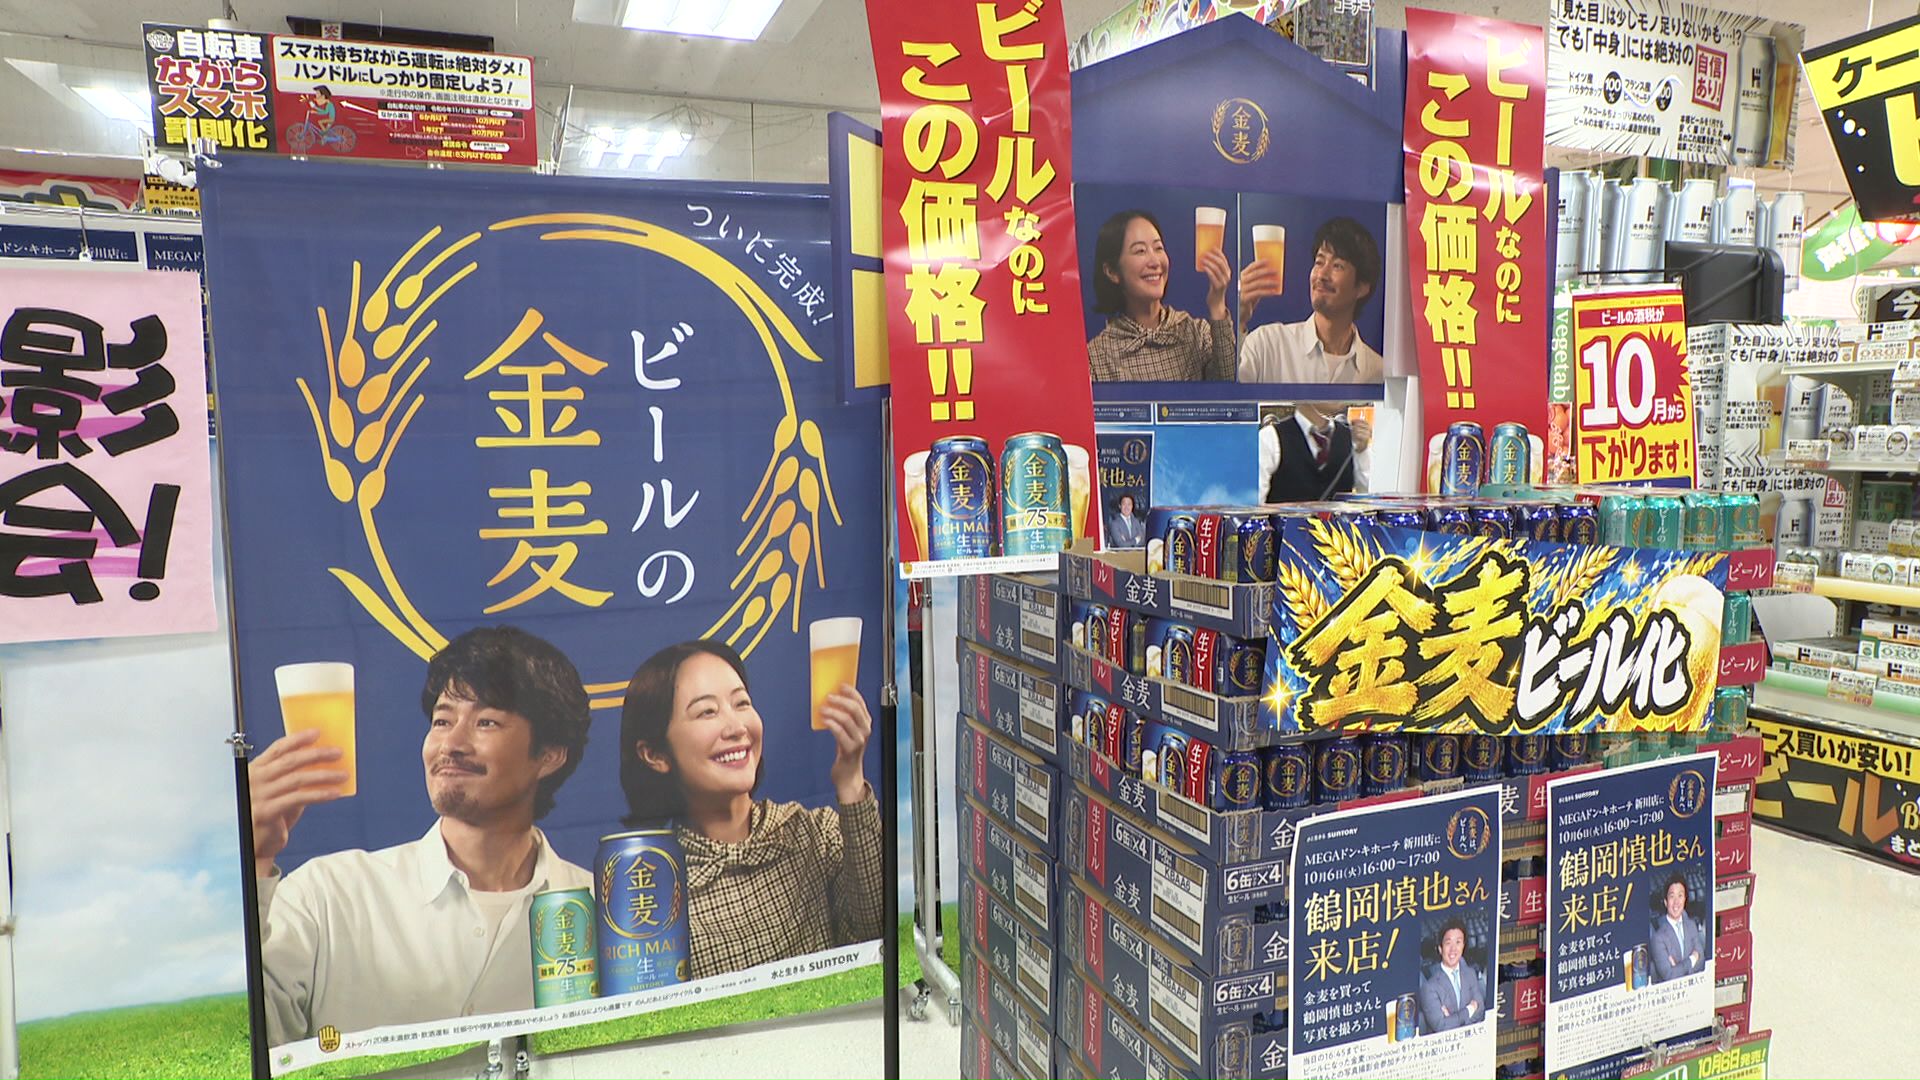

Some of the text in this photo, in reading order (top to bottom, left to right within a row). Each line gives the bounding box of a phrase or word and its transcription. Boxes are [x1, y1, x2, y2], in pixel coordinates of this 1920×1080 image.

[177, 29, 263, 61] 自転車
[280, 41, 524, 76] スマホ持ちながら運転は絶対ダメ!
[1557, 25, 1694, 66] でも「中身」には絶対の
[155, 55, 267, 92] ながら
[294, 63, 513, 94] ハンドルにしっかり固定しよう!
[1697, 52, 1722, 79] 自信
[158, 84, 269, 120] スマホ
[1695, 77, 1723, 105] あり!
[164, 116, 268, 148] 罰則化
[1231, 105, 1252, 158] 金麦
[976, 0, 1056, 315] ビールなのに
[1482, 35, 1533, 323] ビールなのに
[899, 41, 987, 422] この価格!!
[1418, 71, 1479, 409] この価格!!
[686, 203, 834, 326] ついに完成!
[1601, 307, 1665, 325] ビールの酒税が
[1729, 349, 1838, 363] でも「中身」には絶対の
[0, 307, 179, 459] 影
[1582, 337, 1685, 425] 10月から
[463, 307, 614, 614] 金麦
[631, 322, 700, 605] ビールの
[1455, 438, 1472, 487] 金麦
[1502, 438, 1519, 485] 金麦
[1581, 430, 1689, 480] 下がります!
[948, 456, 975, 512] 金麦
[1022, 453, 1048, 506] 金麦
[1721, 477, 1825, 492] でも「中身」には絶対の
[956, 533, 971, 548] 生
[1030, 529, 1044, 545] 生
[1199, 517, 1213, 579] 生ビー
[1728, 560, 1768, 583] ビール
[1125, 574, 1158, 608] 金麦
[995, 623, 1014, 652] 金麦
[1299, 555, 1688, 726] 金麦ビール化
[1197, 632, 1210, 691] 生ビー
[1245, 655, 1259, 685] 金麦
[1719, 657, 1761, 676] ビール
[1121, 675, 1151, 711] 金麦
[995, 707, 1015, 736] 金麦
[1379, 748, 1394, 780] 金麦
[1439, 740, 1453, 771] 金麦
[1476, 735, 1491, 766] 金麦
[1716, 751, 1757, 776] ビール
[1190, 743, 1203, 802] 生ビー
[1236, 766, 1250, 800] 金麦
[1281, 760, 1297, 793] 金麦
[1331, 754, 1346, 787] 金麦
[991, 787, 1009, 819] 金麦
[1118, 774, 1147, 813] 金麦
[1558, 794, 1665, 827] MEGAドン・キホーテ 新川店に
[1090, 804, 1100, 870] 生ビール
[1304, 833, 1440, 867] MEGAドン・キホーテ 新川店に
[1327, 827, 1358, 840] SUNTORY
[1558, 828, 1706, 892] 鶴岡慎也さん
[624, 856, 660, 929] 金麦
[1113, 873, 1142, 915] 金麦
[1227, 893, 1250, 905] 生ビール
[1304, 870, 1490, 937] 鶴岡慎也さん
[1524, 890, 1543, 915] 生
[1558, 882, 1634, 934] 来店!
[552, 906, 577, 956] 金麦
[1088, 901, 1099, 966] 生ビール
[1262, 929, 1289, 964] 金
[1557, 932, 1612, 958] 金麦を買って
[606, 943, 640, 960] RICH
[636, 957, 655, 975] 生
[771, 951, 861, 981] 水と生きる SUNTORY
[1303, 927, 1400, 982] 来店!
[1557, 947, 1621, 976] 鶴岡慎也さんと
[1112, 973, 1140, 1015] 金麦
[1303, 980, 1372, 1006] 金麦を買って
[1557, 967, 1616, 993] 写真を撮ろう!
[1087, 992, 1097, 1055] 生ビール
[1216, 1004, 1240, 1016] 生ビール
[1303, 996, 1382, 1026] 鶴岡慎也さんと
[1303, 1016, 1375, 1045] 写真を撮ろう!
[1260, 1039, 1288, 1073] 金
